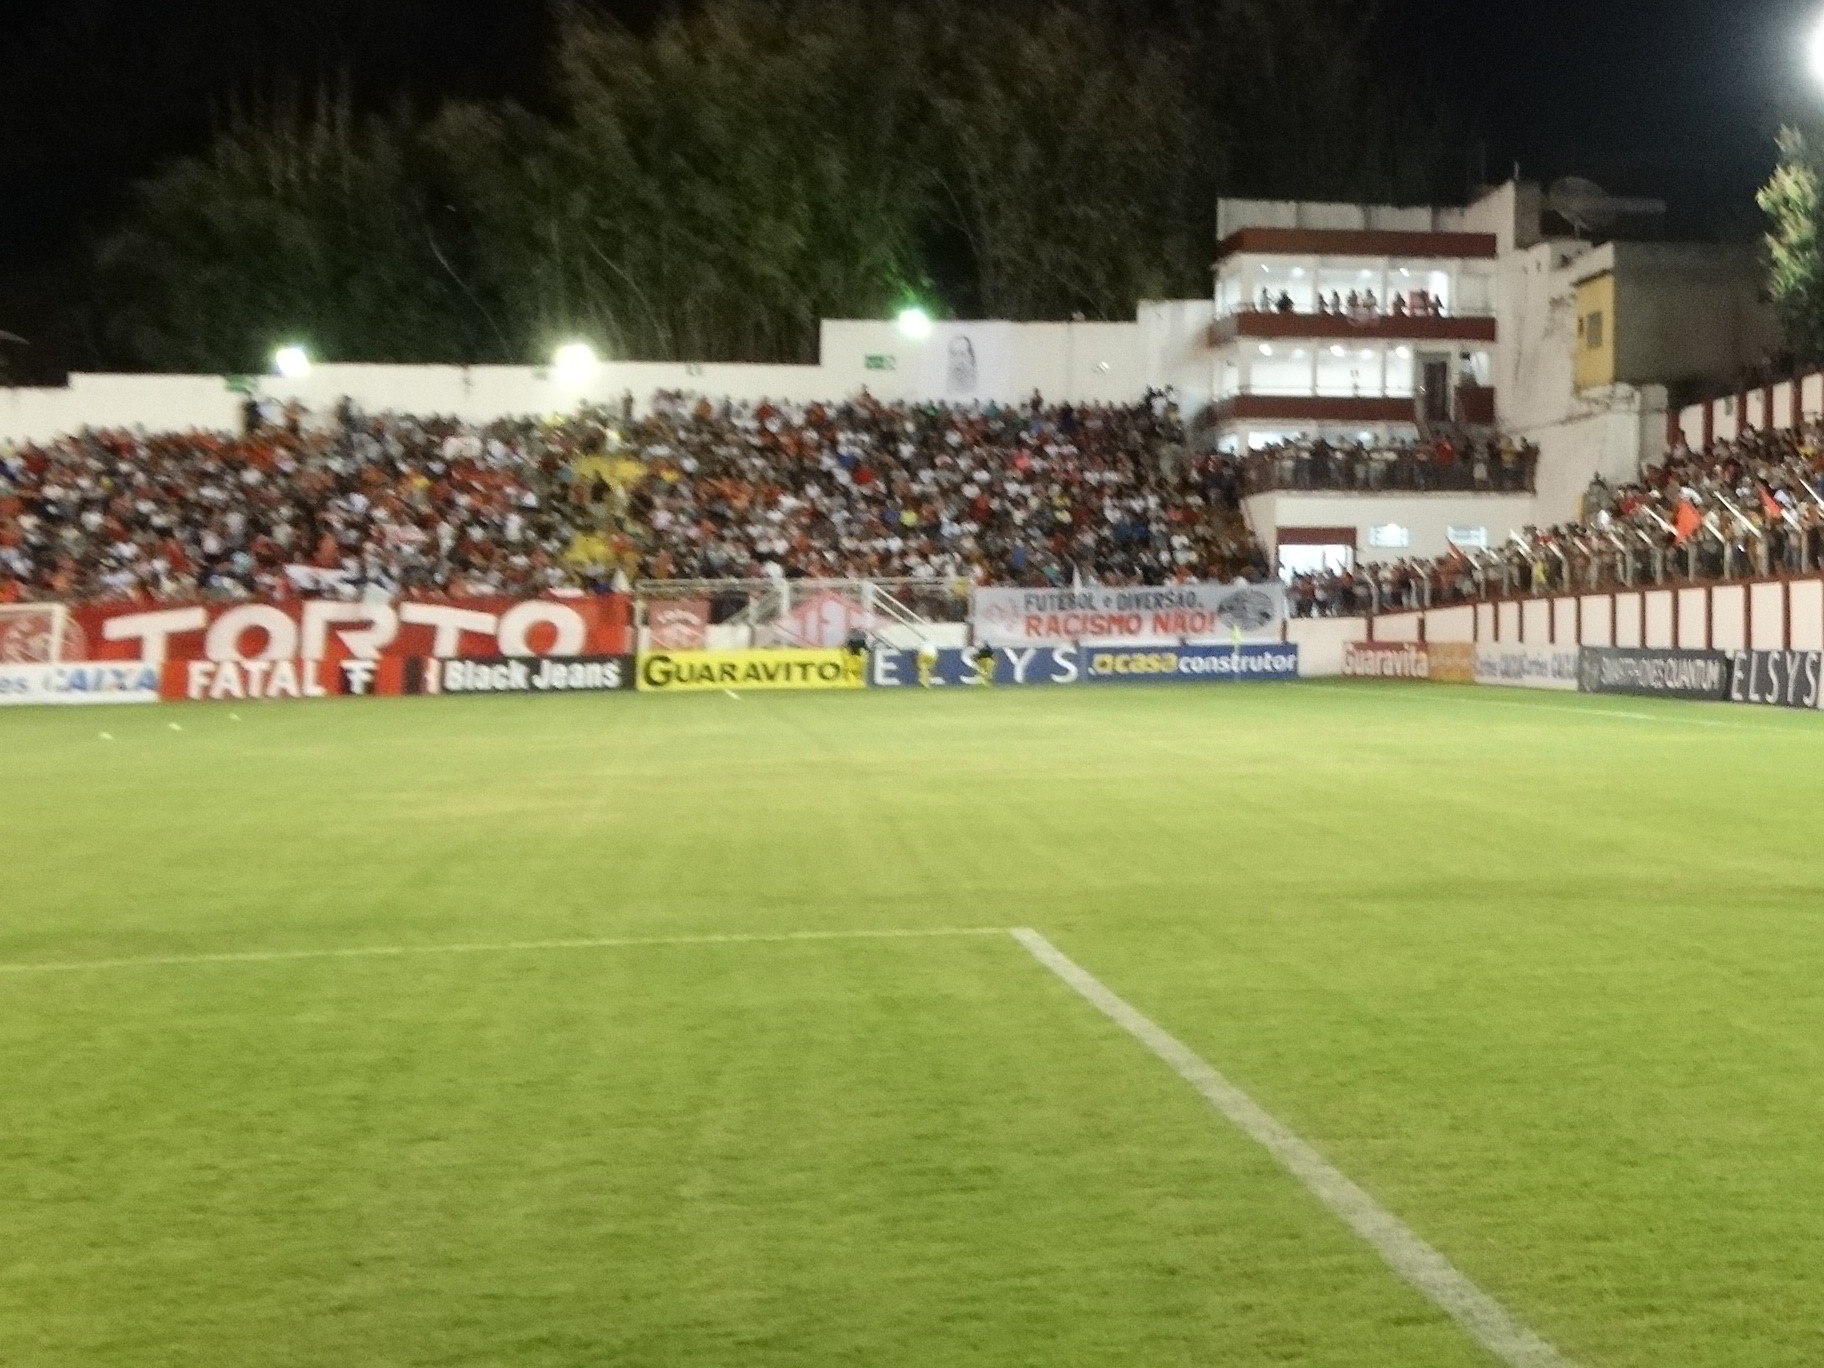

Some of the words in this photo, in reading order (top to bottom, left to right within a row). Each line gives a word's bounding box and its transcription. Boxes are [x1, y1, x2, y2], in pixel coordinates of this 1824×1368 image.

[102, 603, 588, 663] TORTO
[1024, 612, 1143, 637] RACISMO
[187, 659, 327, 699] FATAL
[444, 660, 529, 692] Black
[532, 658, 622, 692] Jeans
[644, 654, 861, 687] GUARAVITO
[1730, 650, 1819, 708] ELSYS
